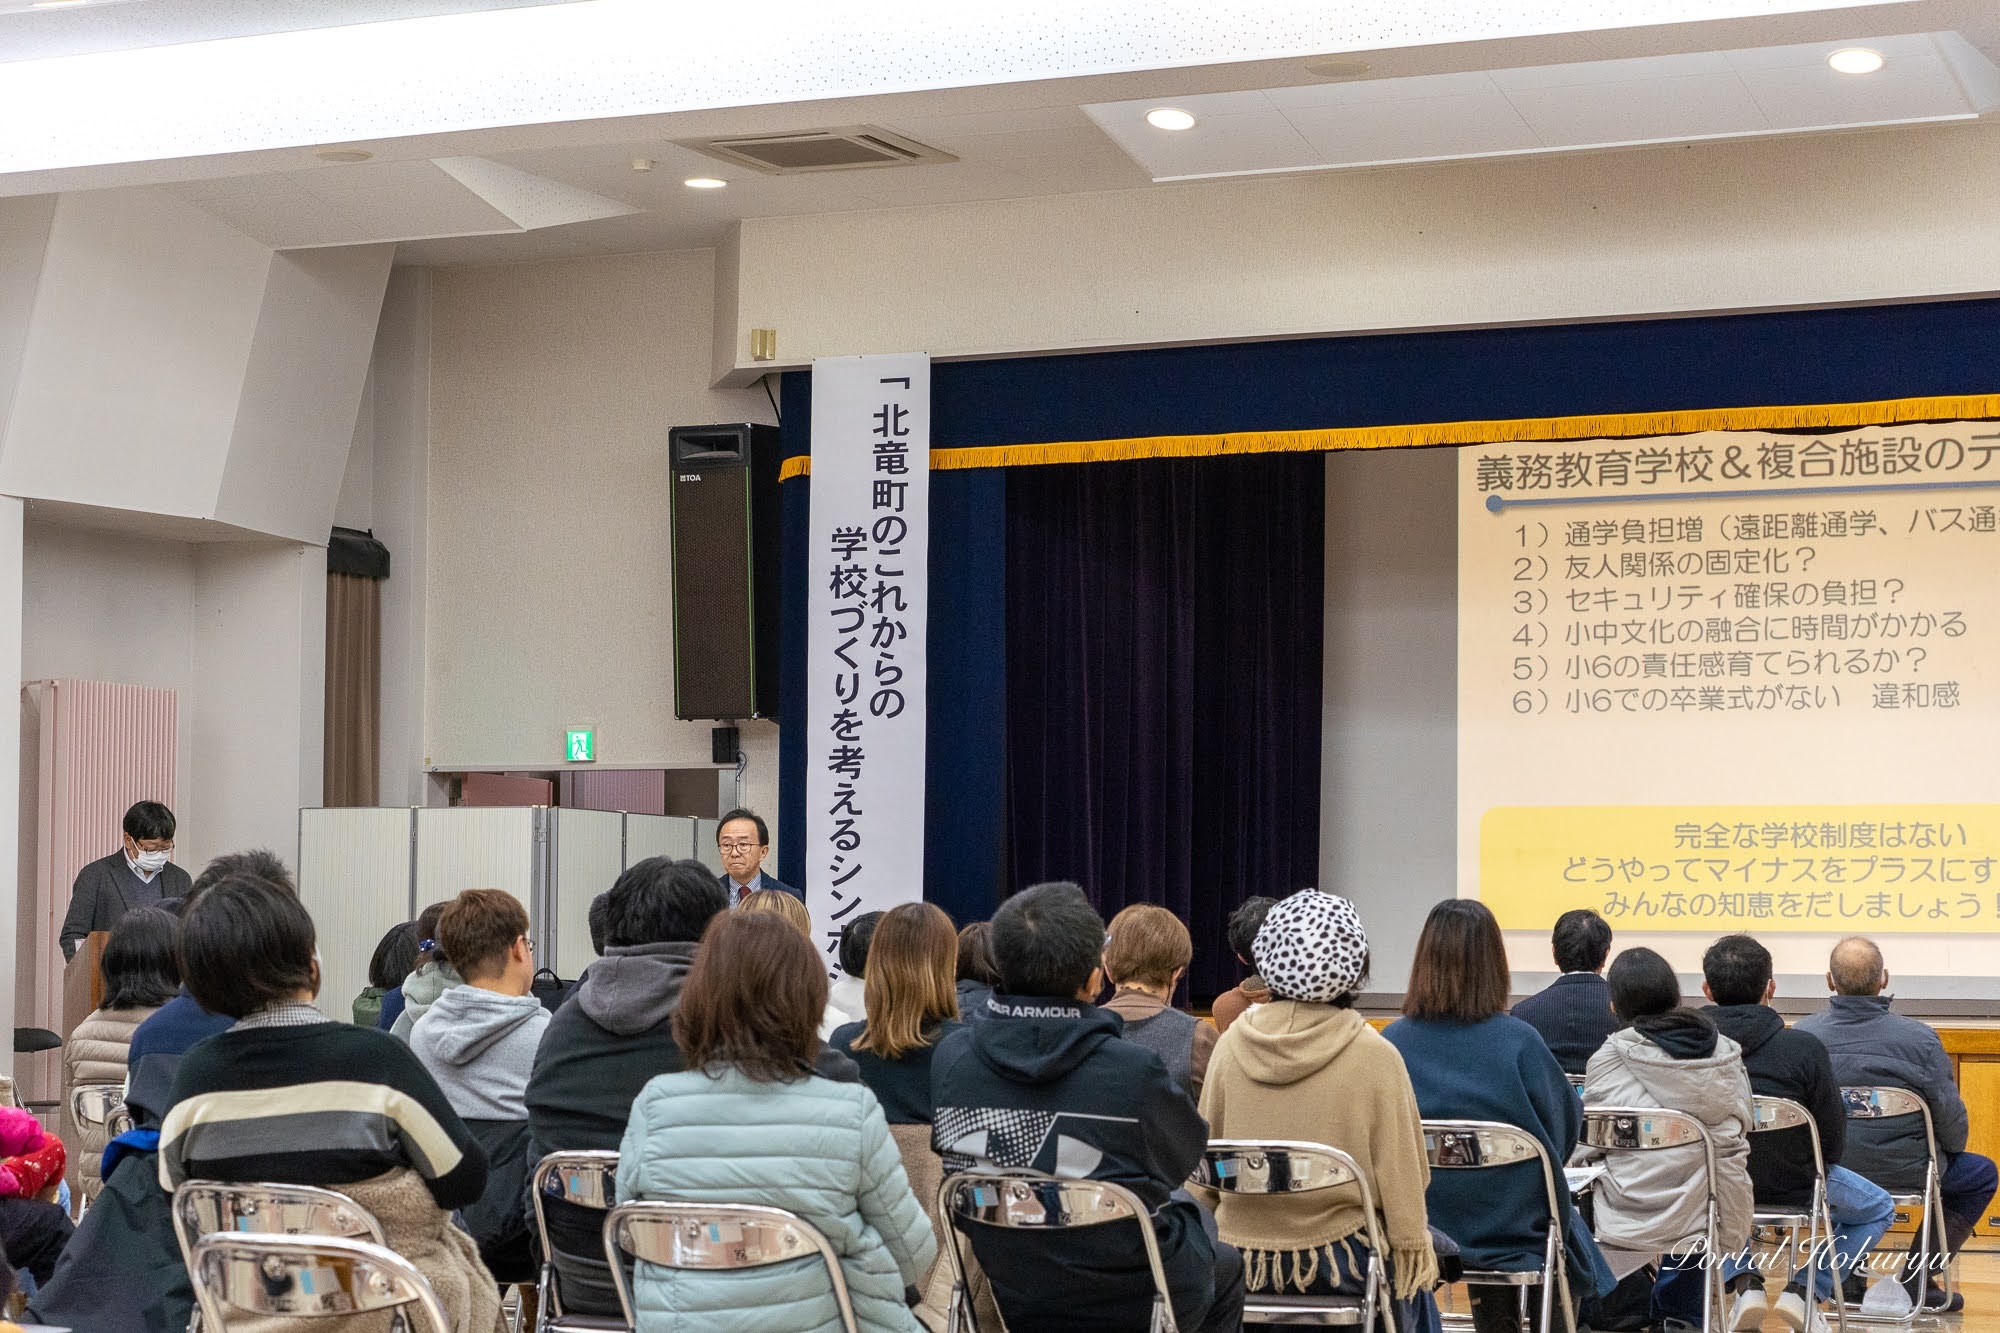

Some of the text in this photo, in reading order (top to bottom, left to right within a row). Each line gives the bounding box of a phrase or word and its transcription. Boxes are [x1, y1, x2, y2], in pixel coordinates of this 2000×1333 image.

[686, 474, 702, 482] TOA
[1514, 505, 2000, 548] 1）通学負担増（遠距離通学、バス通
[869, 376, 911, 720] 「北竜町のこれからの
[1871, 680, 1961, 711] 違和感
[826, 526, 869, 980] 学校づくりを考えるシン
[1673, 820, 1967, 850] 完全な学校制度はない
[1562, 855, 1998, 884] どうやってマイナスをプラスにす
[1011, 1005, 1081, 1018] ARMOUR
